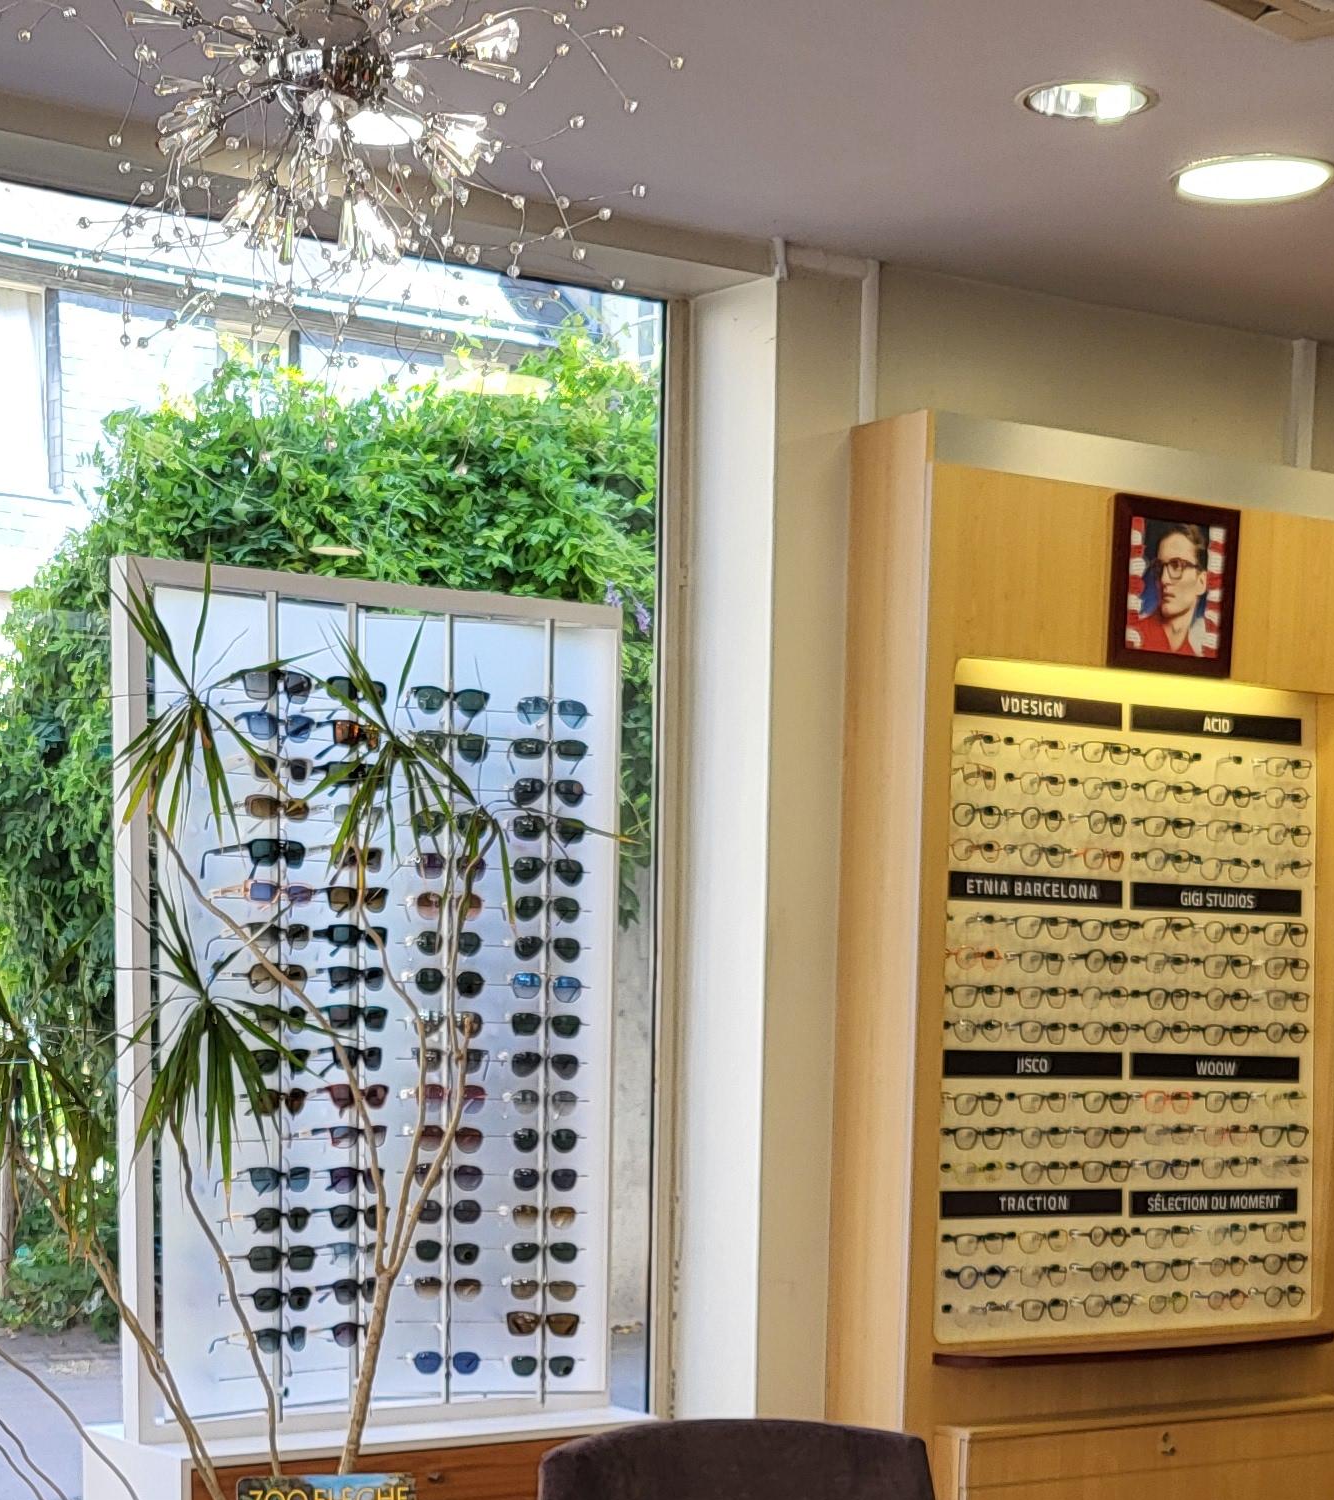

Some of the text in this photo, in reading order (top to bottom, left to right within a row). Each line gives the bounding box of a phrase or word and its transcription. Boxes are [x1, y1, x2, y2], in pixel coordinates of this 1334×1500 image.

[1202, 715, 1234, 735] ACID
[965, 878, 1099, 901] ETNIA BARCELONA
[1179, 890, 1256, 910] GIGI STUDIOS
[1195, 1060, 1237, 1078] WOOW
[998, 1194, 1069, 1212] TRACTION
[1210, 1195, 1227, 1210] DU
[1229, 1193, 1281, 1210] MOMENT
